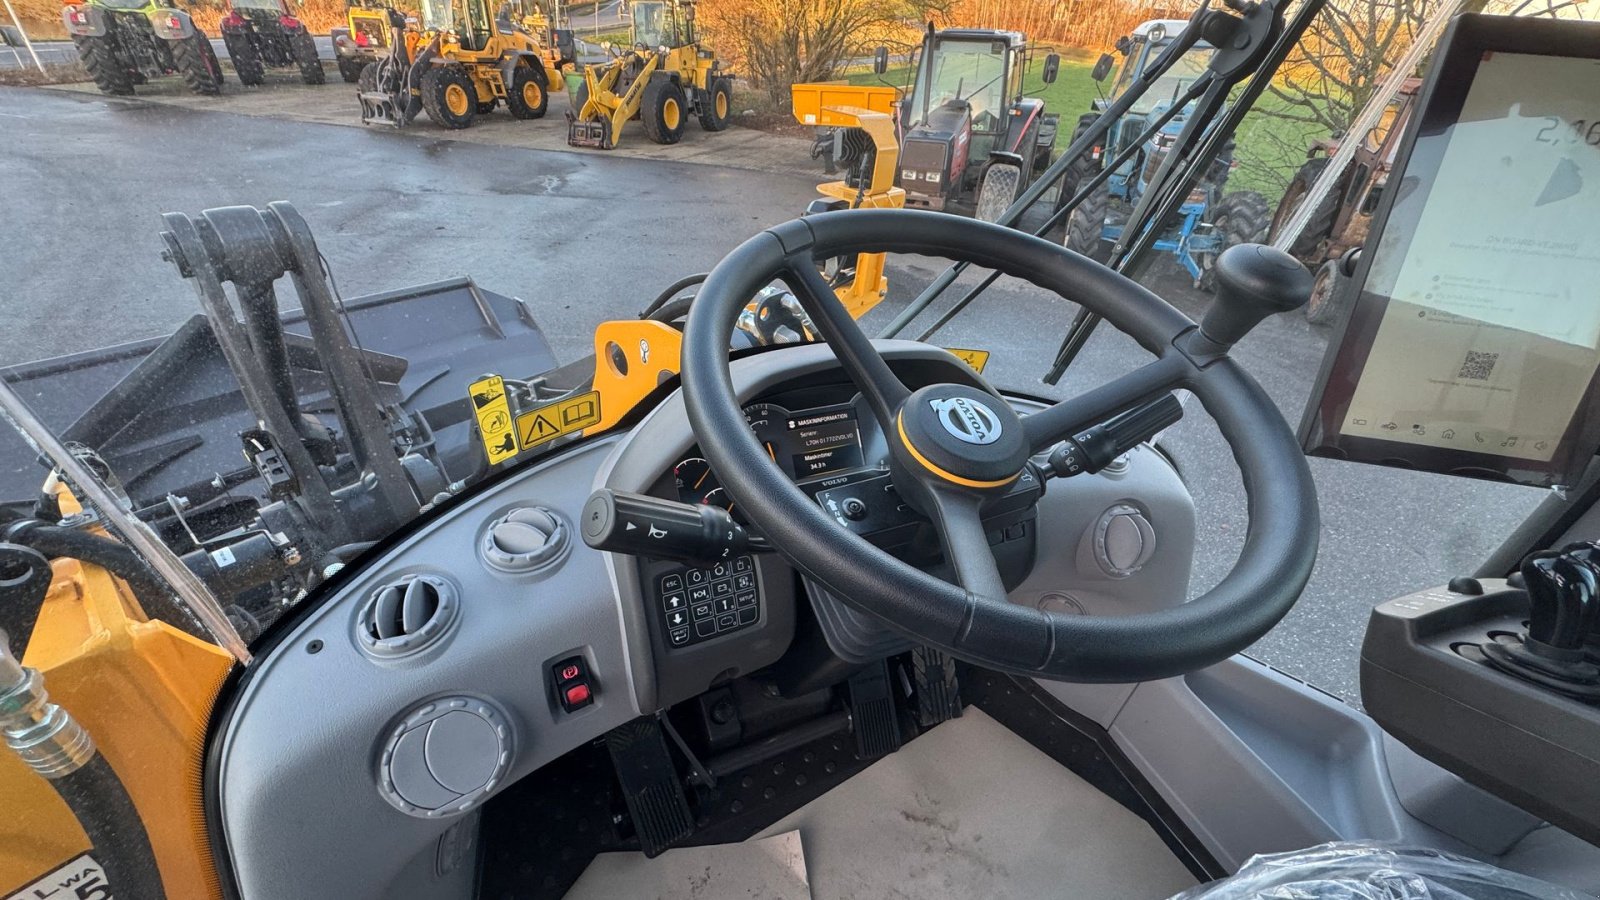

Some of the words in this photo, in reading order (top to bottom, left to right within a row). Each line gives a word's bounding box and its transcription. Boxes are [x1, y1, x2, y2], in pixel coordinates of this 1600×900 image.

[797, 413, 848, 426] MASKININFORMATION
[955, 399, 986, 441] VOLVO
[821, 477, 848, 487] VOLVO
[825, 492, 831, 500] F
[727, 531, 733, 540] 3
[722, 548, 729, 557] 2
[666, 580, 679, 588] ESC
[739, 593, 754, 602] SETUP
